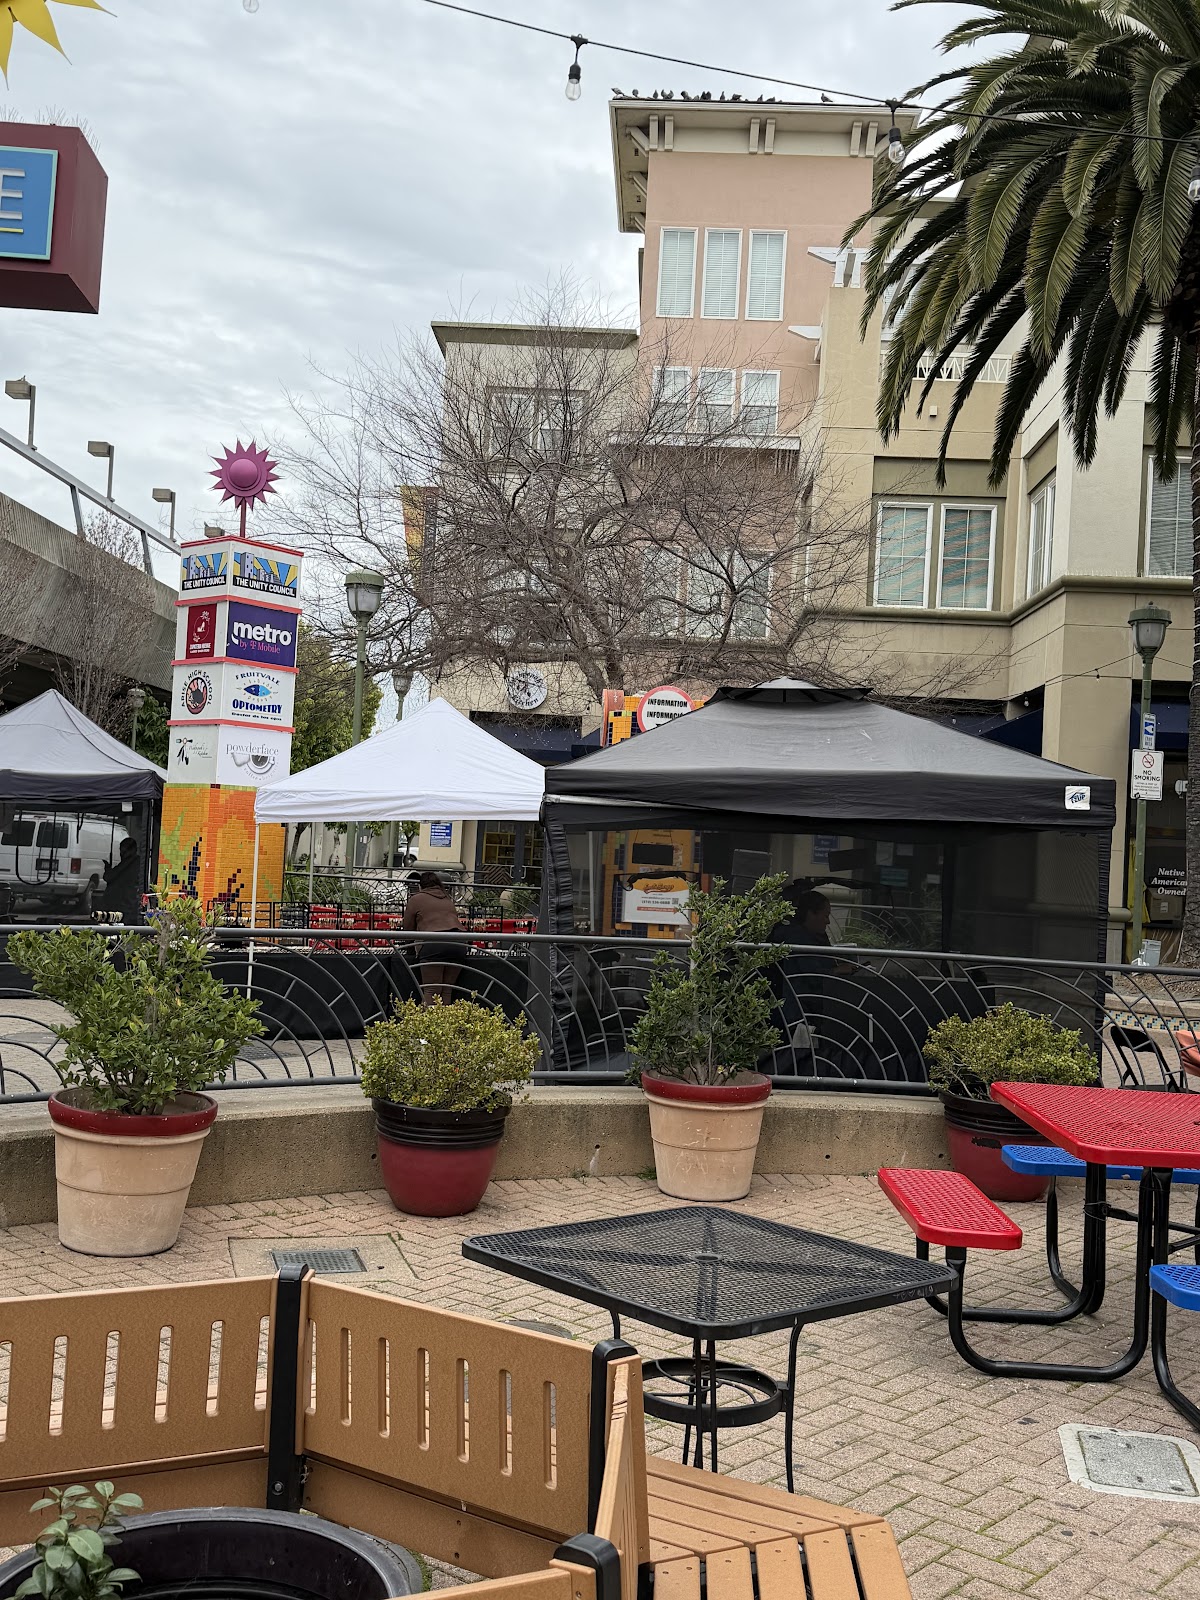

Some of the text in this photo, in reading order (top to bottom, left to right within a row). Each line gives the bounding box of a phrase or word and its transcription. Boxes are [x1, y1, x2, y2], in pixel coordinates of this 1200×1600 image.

[183, 575, 226, 589] THE UNITY COUNCIL
[236, 577, 296, 597] THE UNITY COUNCIL
[233, 621, 292, 646] metro
[239, 640, 248, 651] by
[235, 671, 281, 686] FRUITVALE
[187, 669, 203, 681] HIGH
[202, 671, 213, 706] SCHOOL
[232, 699, 283, 714] OPTOMETRY
[647, 698, 688, 708] INFORMATION
[226, 742, 279, 756] powderface
[1157, 867, 1186, 877] Native
[1157, 886, 1187, 896] Owned
